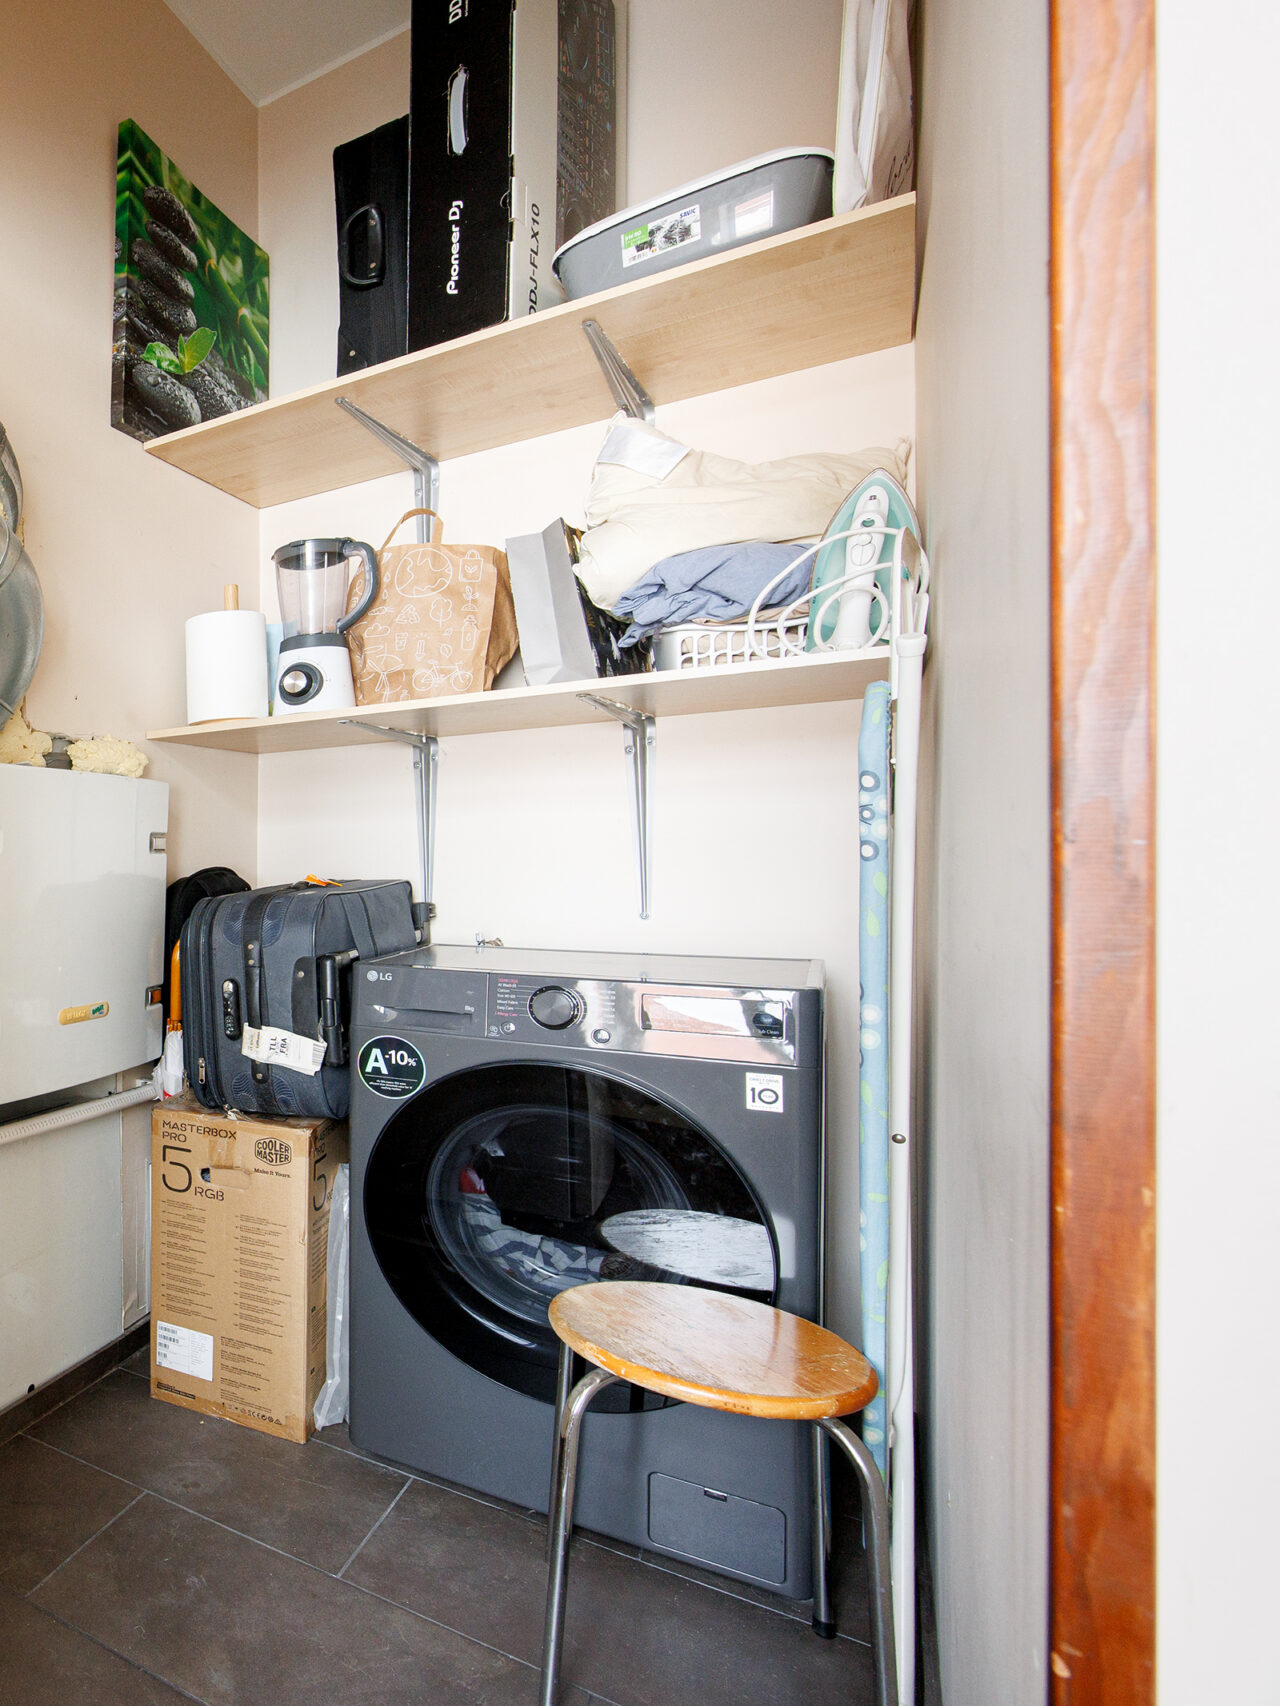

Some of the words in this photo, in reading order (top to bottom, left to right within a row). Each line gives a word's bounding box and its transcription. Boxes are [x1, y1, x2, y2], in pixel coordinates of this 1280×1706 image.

[446, 224, 460, 295] Pioneer
[379, 972, 393, 981] LG
[280, 1037, 288, 1054] FRA
[750, 1087, 780, 1105] 10
[162, 1119, 237, 1140] MASTERBOX
[162, 1131, 187, 1143] PRO
[256, 1139, 290, 1154] COOLER
[256, 1149, 290, 1164] MASTER
[162, 1144, 193, 1193] 5
[194, 1186, 225, 1202] RGB
[254, 1167, 269, 1175] Make
[312, 1152, 327, 1212] 5
